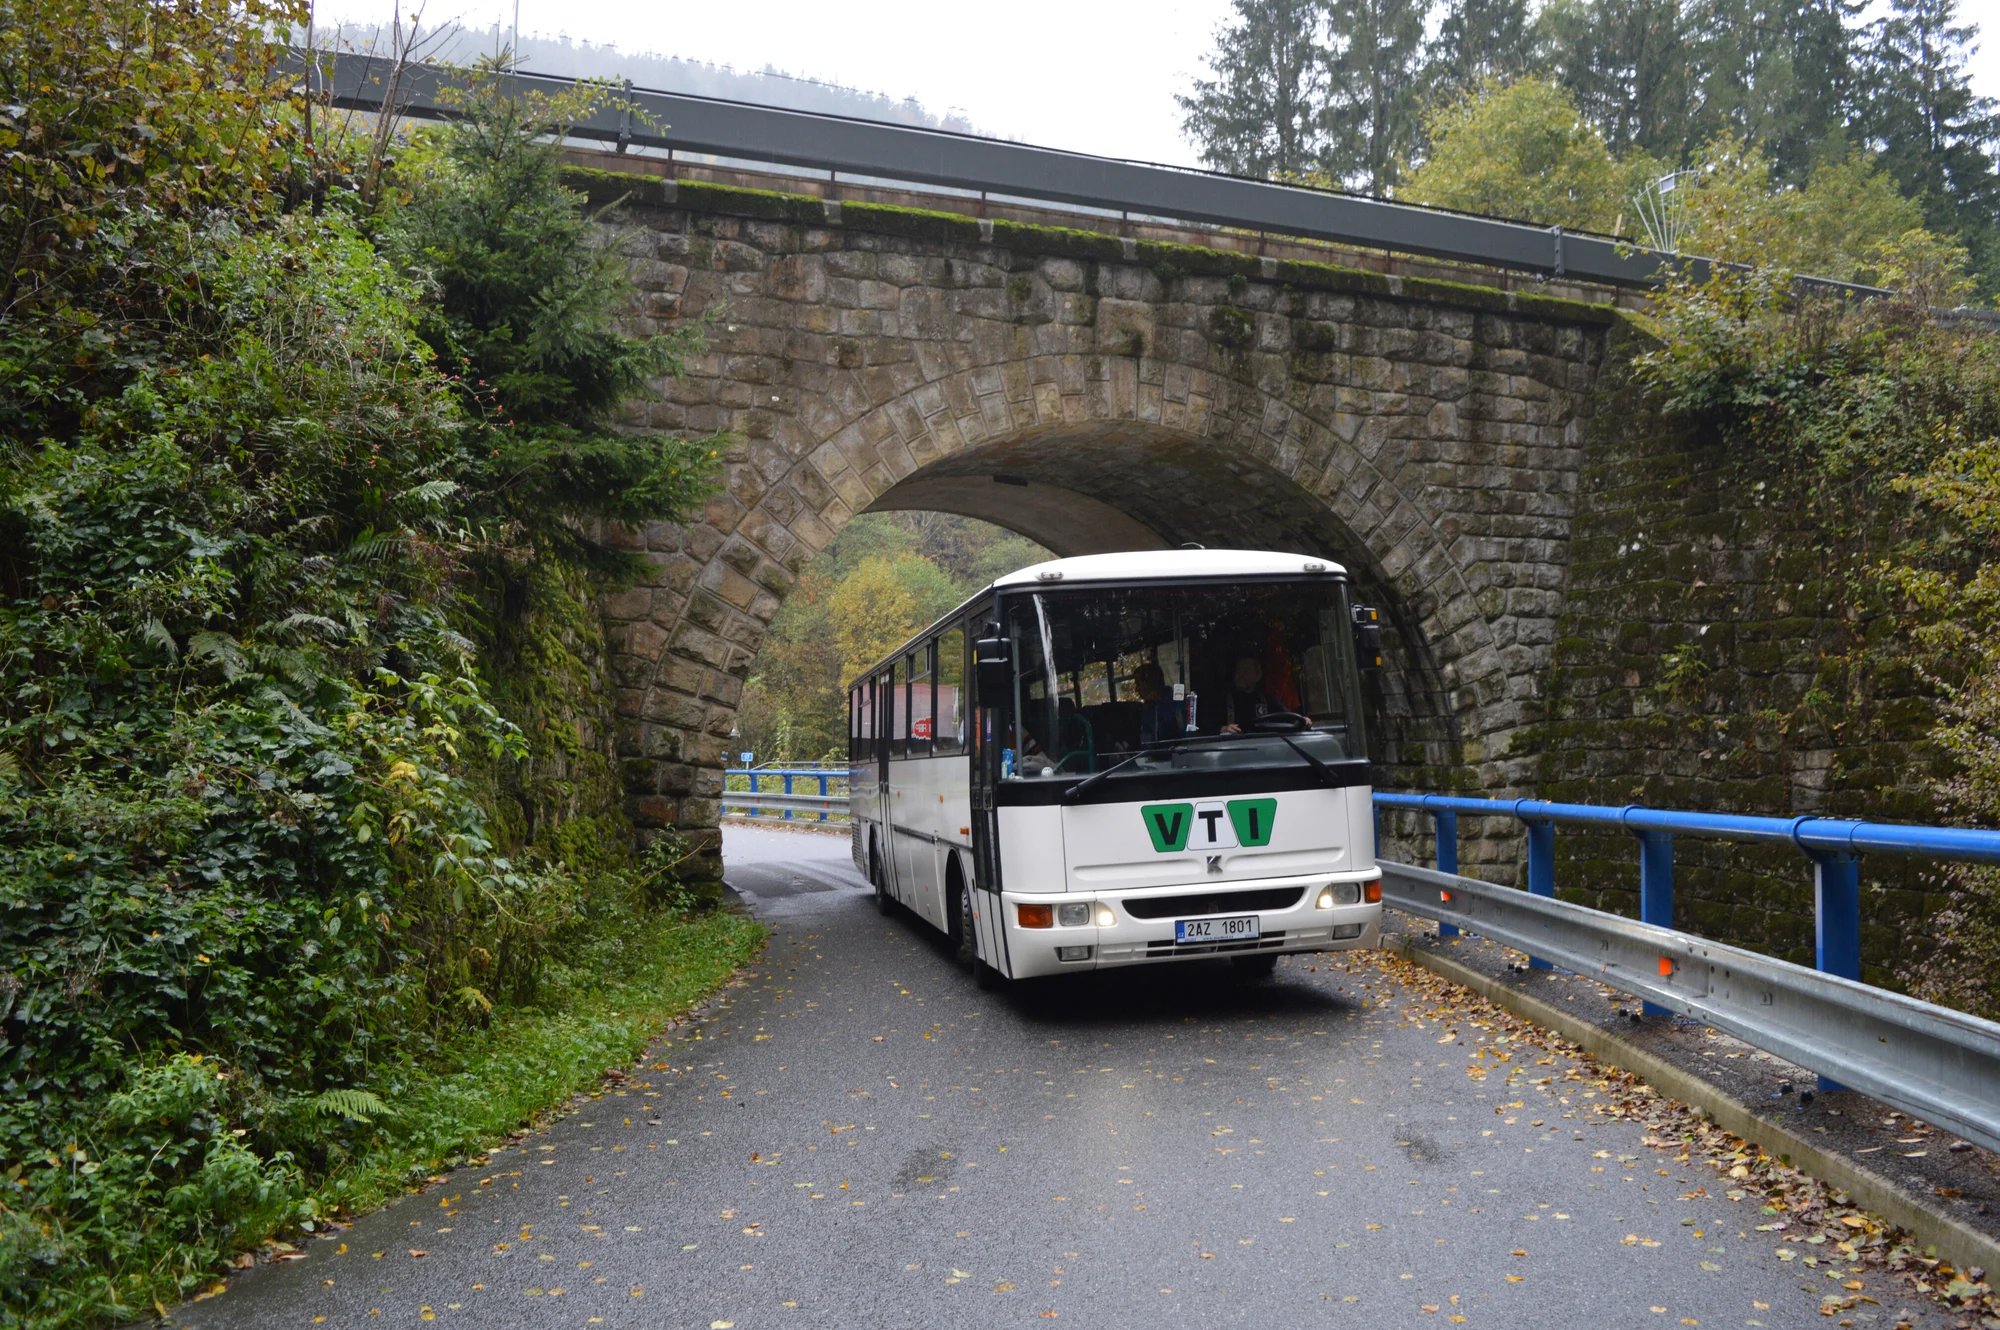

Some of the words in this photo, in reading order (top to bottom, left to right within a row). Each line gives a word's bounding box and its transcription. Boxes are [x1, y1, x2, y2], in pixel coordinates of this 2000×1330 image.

[1153, 808, 1260, 846] VTI
[1187, 922, 1211, 937] 2AZ
[1222, 919, 1252, 935] 1801
